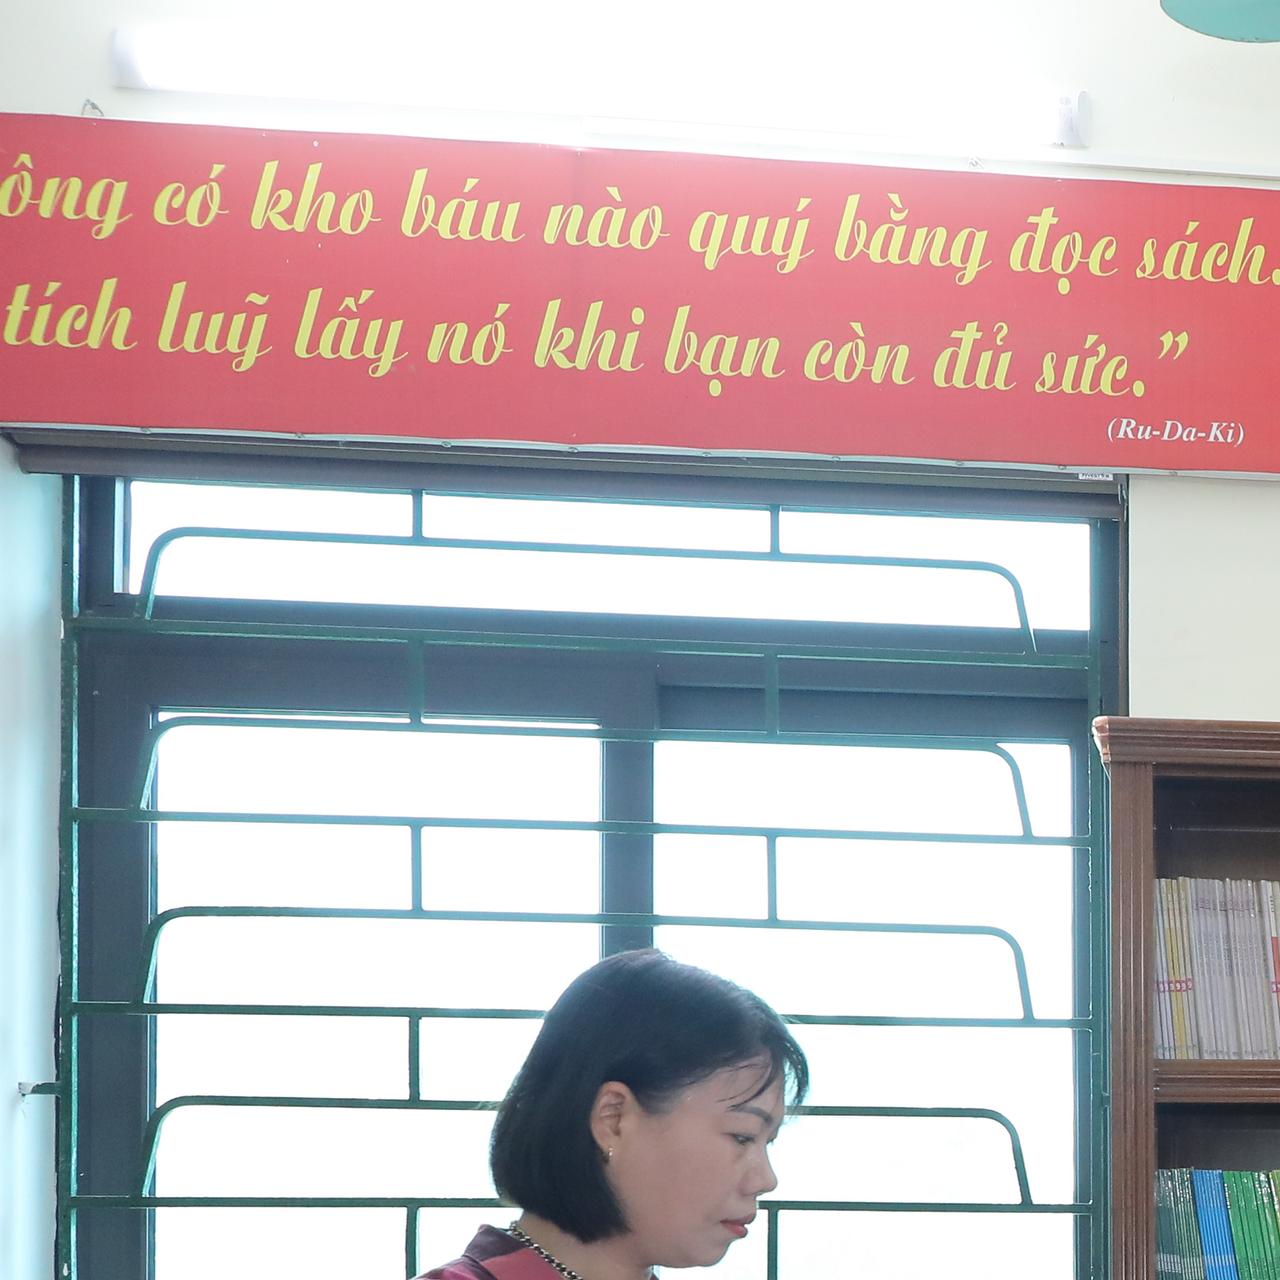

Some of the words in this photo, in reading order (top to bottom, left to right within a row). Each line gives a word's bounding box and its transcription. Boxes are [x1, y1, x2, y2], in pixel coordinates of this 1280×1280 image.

[153, 163, 229, 228] có
[250, 160, 381, 235] kho
[400, 167, 526, 242] báu
[544, 187, 671, 250] nào
[689, 198, 815, 273] quý
[834, 192, 992, 286] bằng
[1009, 205, 1120, 295] đọc
[4, 278, 137, 351] tích
[158, 281, 272, 372] luỹ
[295, 288, 408, 377] lấy
[427, 303, 513, 366] nó
[534, 298, 644, 371] khi
[664, 305, 785, 397] bạn
[804, 322, 915, 385] còn
[933, 321, 1016, 390] đủ
[1107, 417, 1244, 446] (Ru-Da-Ki)
